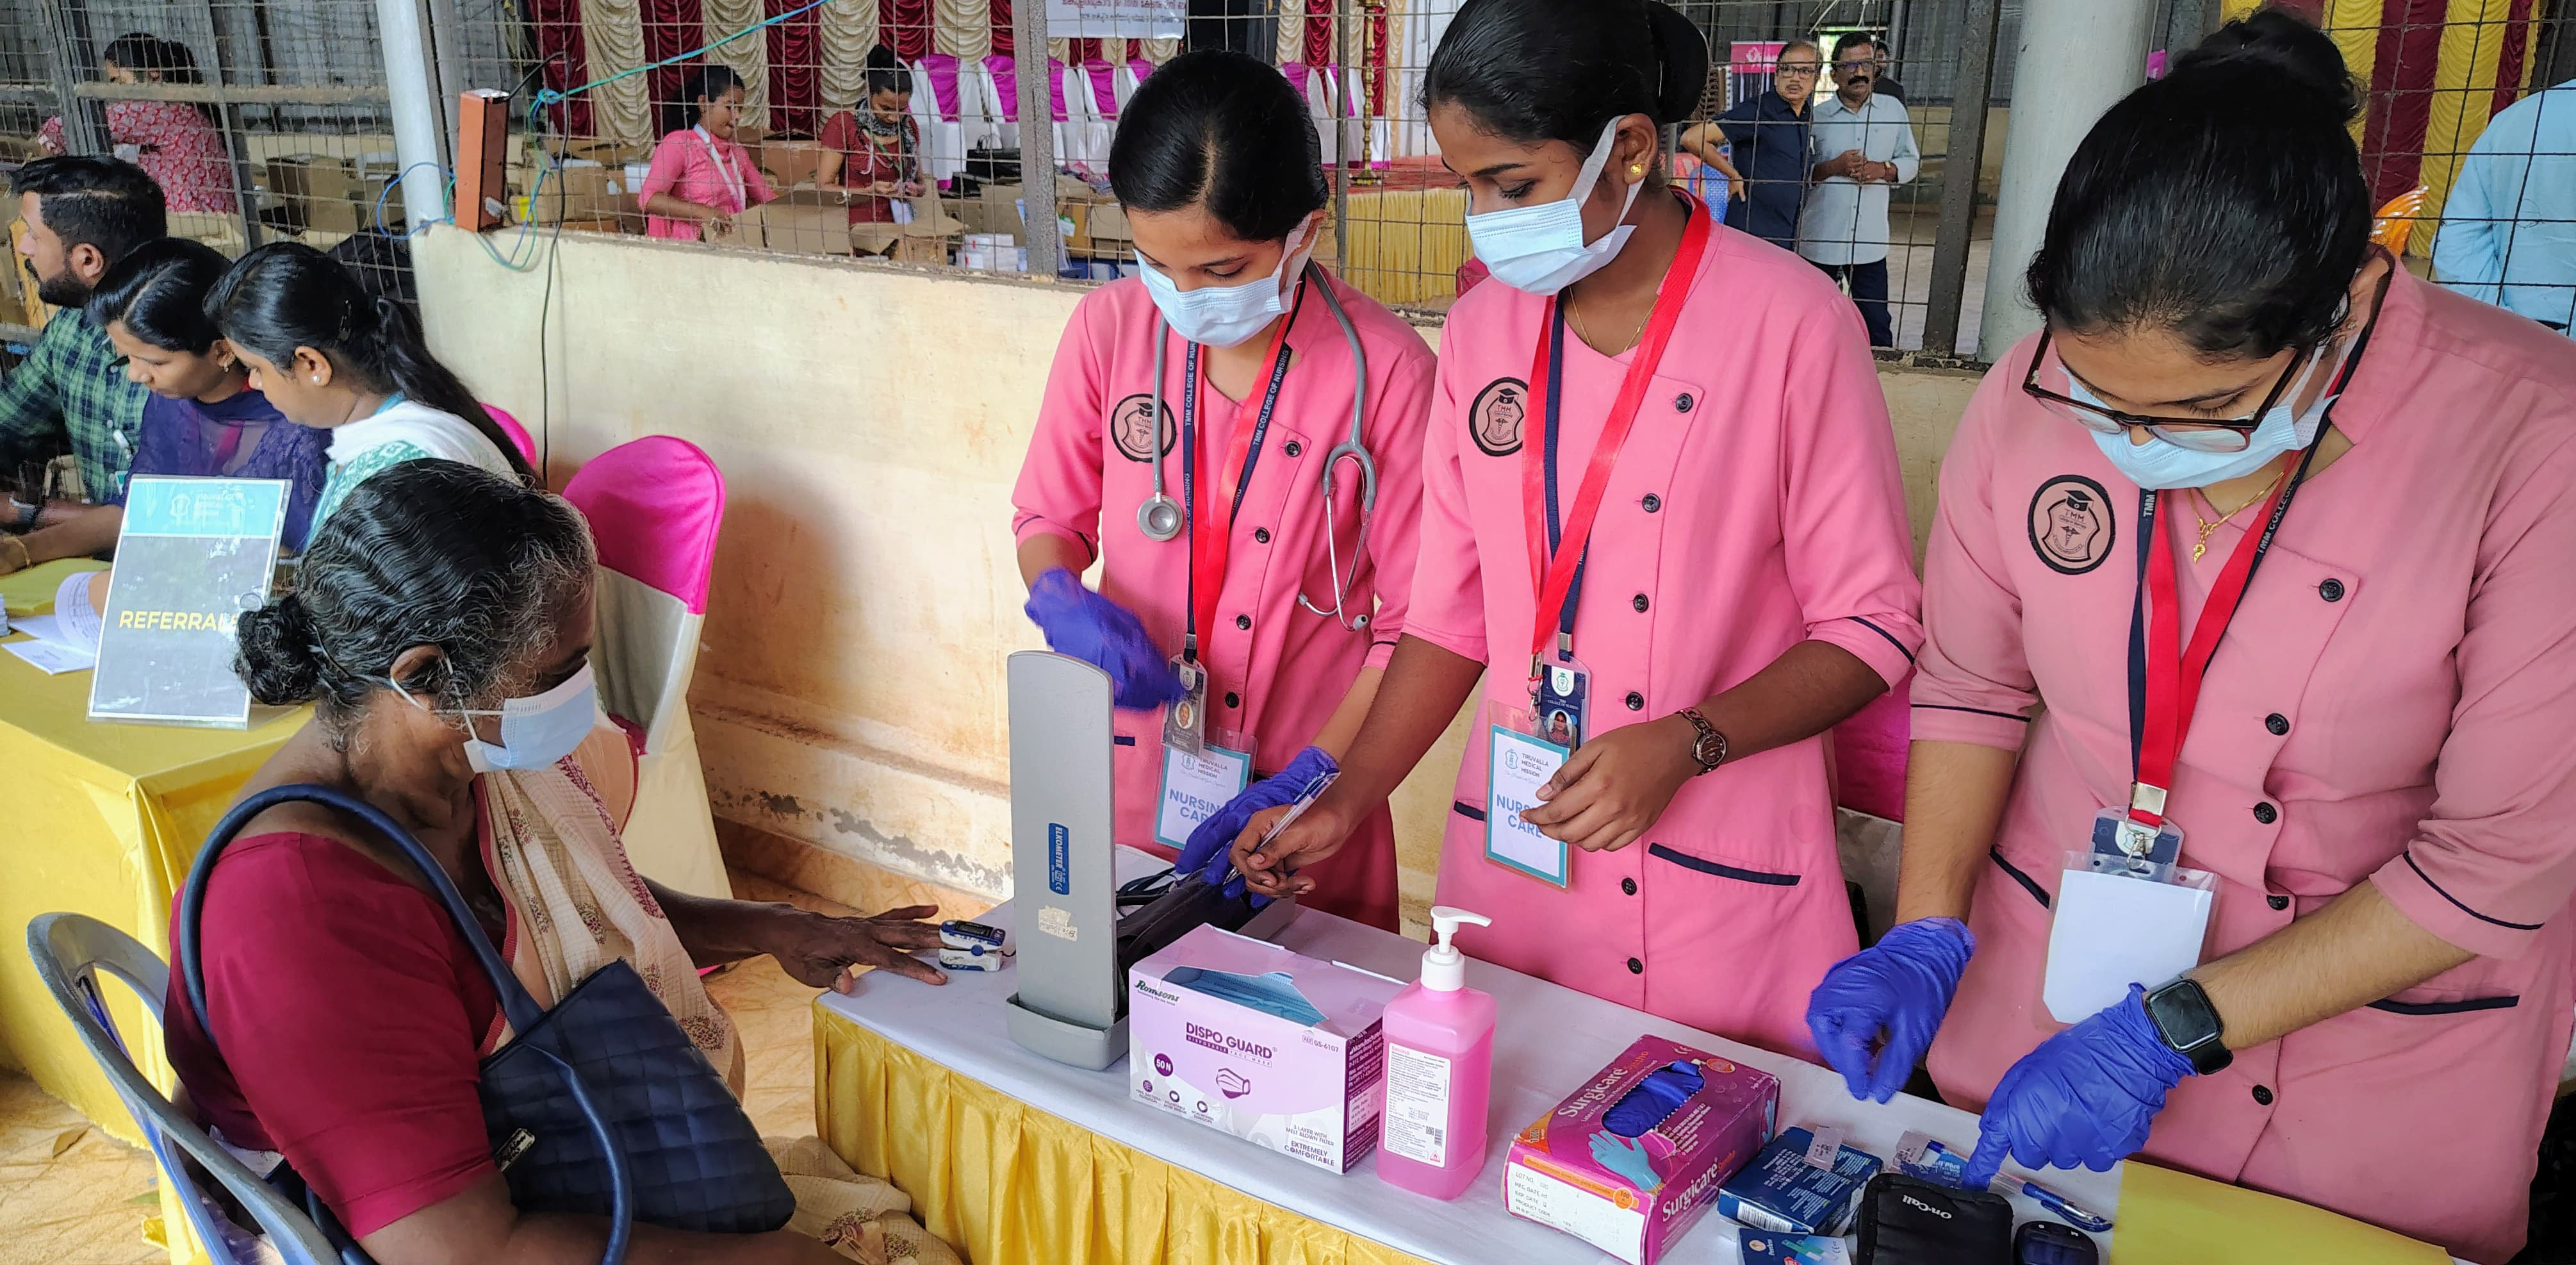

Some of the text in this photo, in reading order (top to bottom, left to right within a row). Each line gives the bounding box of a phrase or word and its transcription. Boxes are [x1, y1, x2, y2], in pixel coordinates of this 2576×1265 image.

[1188, 360, 1195, 370] OF
[1186, 372, 1194, 408] COLLEGE
[1252, 350, 1290, 445] TMM COLLEGE OF NURSING
[2143, 494, 2155, 517] TMM
[2064, 508, 2085, 522] TMM
[2258, 531, 2272, 554] TMM
[1521, 760, 1543, 772] MEDICAL
[1522, 752, 1549, 766] TIRUVALLA
[1197, 769, 1218, 779] MISSION
[1198, 763, 1220, 774] MEDICAL
[1520, 768, 1540, 778] MISSION
[1169, 789, 1220, 813] NURSIN
[1055, 827, 1063, 868] ELKOMETER
[1134, 980, 1180, 1002] Romsons
[1186, 1021, 1272, 1059] DISPO GUARD
[1314, 1040, 1339, 1053] GS-6107
[1156, 1058, 1171, 1071] 50 N
[1557, 1068, 1628, 1118] Surgicare
[1286, 1127, 1334, 1146] MELT BLOWN FILTER
[1297, 1125, 1313, 1135] LAYER
[1314, 1130, 1327, 1139] WITH
[1284, 1145, 1335, 1166] COMFORTABLE
[1291, 1140, 1328, 1157] EXTREMELY
[1516, 1171, 1525, 1180] LOT
[1527, 1187, 1540, 1197] DATE
[1620, 1190, 1630, 1199] 100
[1662, 1163, 1718, 1222] Surgicare
[1515, 1198, 1537, 1211] PRODUCT
[1526, 1195, 1539, 1204] DATE
